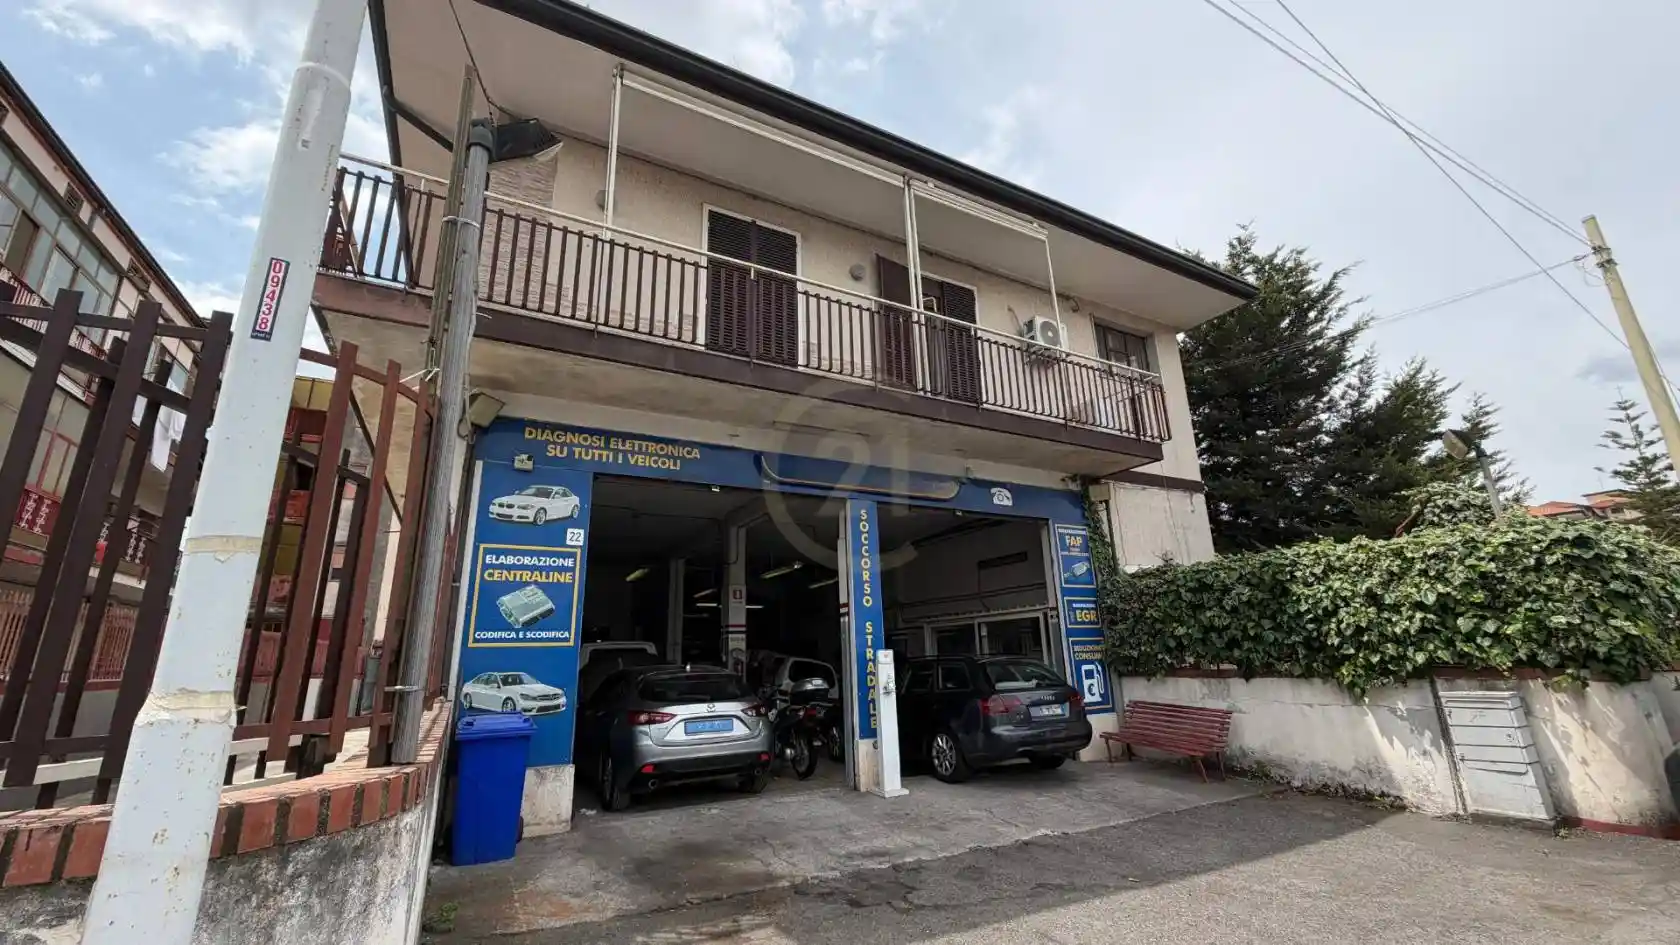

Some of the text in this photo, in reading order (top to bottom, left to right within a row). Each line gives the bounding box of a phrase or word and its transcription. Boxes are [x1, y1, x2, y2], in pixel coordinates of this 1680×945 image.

[259, 261, 283, 330] 09438
[524, 427, 701, 459] DIAGNOSI ELETTRONICA
[546, 445, 681, 471] SU TUTTI I VEICOLI
[568, 531, 582, 542] 22
[485, 554, 575, 567] ELABORAZIONE
[859, 509, 873, 608] SOCCORSO
[484, 569, 573, 583] CENTRALINE
[1076, 609, 1098, 622] EGR
[475, 630, 570, 639] CODIFICA E SCODIFICA
[865, 621, 878, 729] STRADALE
